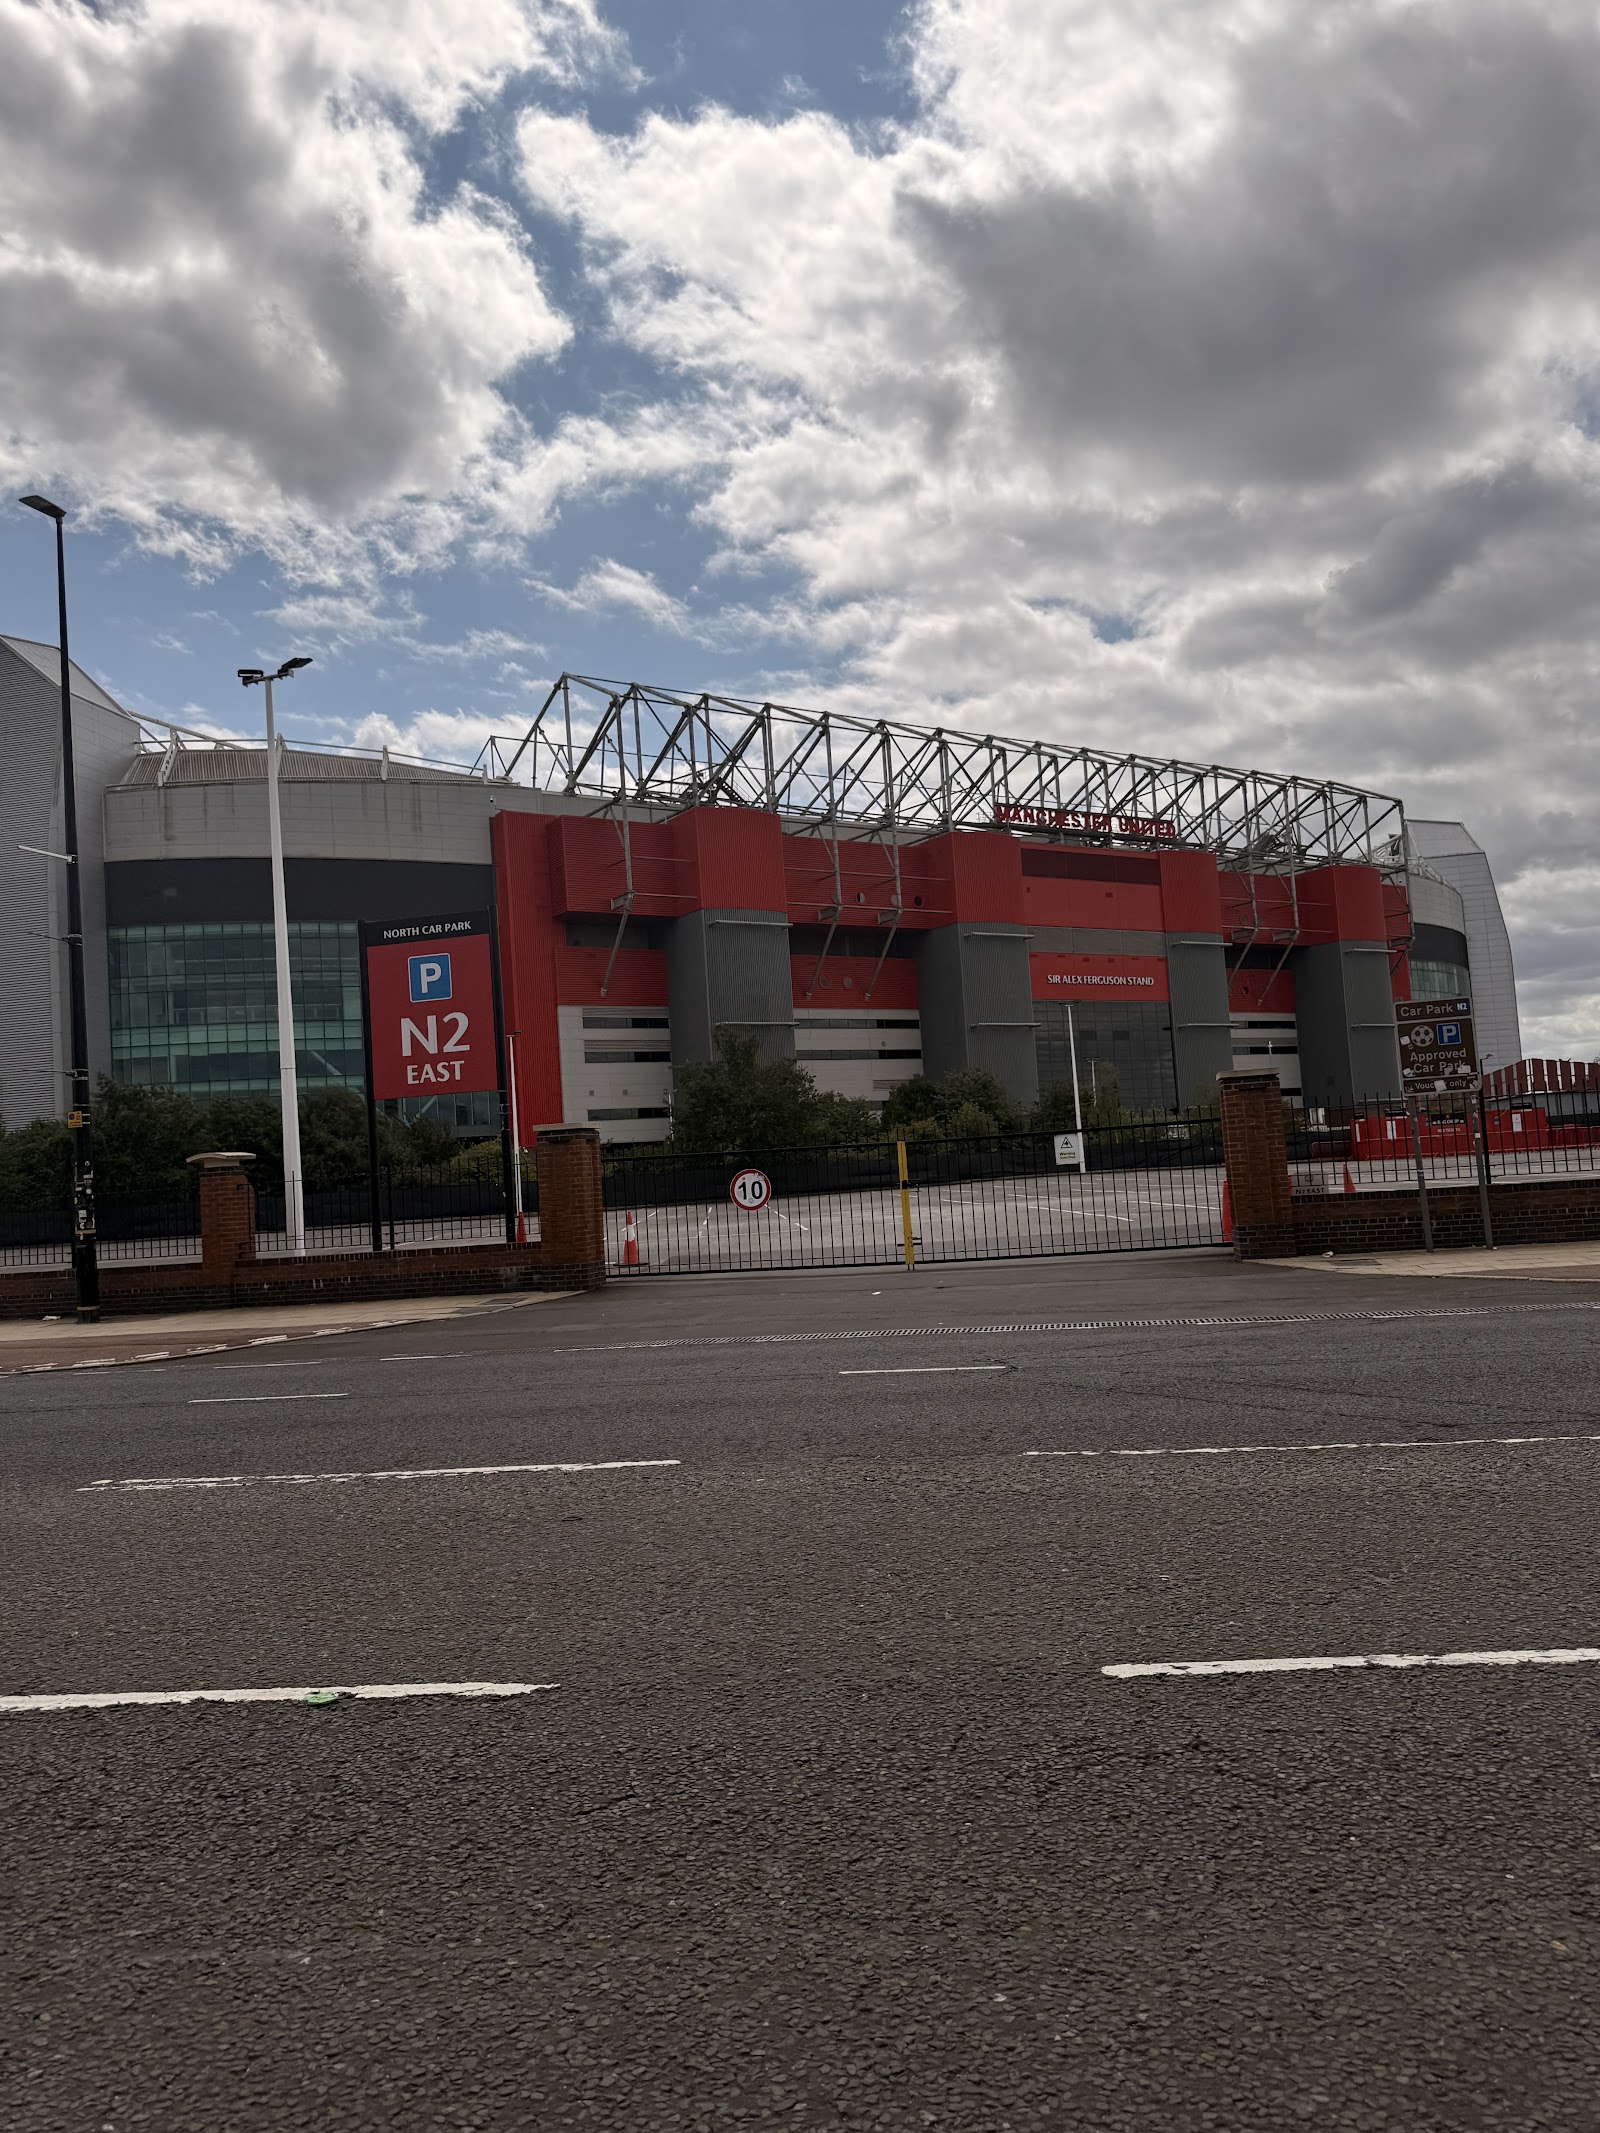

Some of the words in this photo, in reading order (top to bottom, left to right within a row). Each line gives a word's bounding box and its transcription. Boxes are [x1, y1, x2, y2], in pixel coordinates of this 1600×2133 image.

[994, 804, 1112, 833] MANCHESTER
[1118, 816, 1176, 838] UNITED
[383, 926, 419, 939] NORTH
[422, 924, 442, 935] CAR
[445, 920, 472, 931] PARK
[420, 962, 442, 994] P
[1047, 974, 1060, 984] SIR
[1062, 975, 1082, 984] ALEX
[1083, 975, 1127, 985] FERGUSON
[1127, 976, 1154, 986] STAND
[1400, 1006, 1421, 1017] Car
[1426, 1003, 1453, 1015] Park
[1456, 1002, 1468, 1011] N2
[401, 1011, 471, 1057] N2
[1442, 1025, 1457, 1043] P
[1410, 1048, 1467, 1062] Approved
[407, 1060, 465, 1085] EAST
[1413, 1062, 1435, 1074] Car
[1414, 1080, 1447, 1090] Vouc
[1450, 1079, 1467, 1088] only
[738, 1180, 763, 1200] 10
